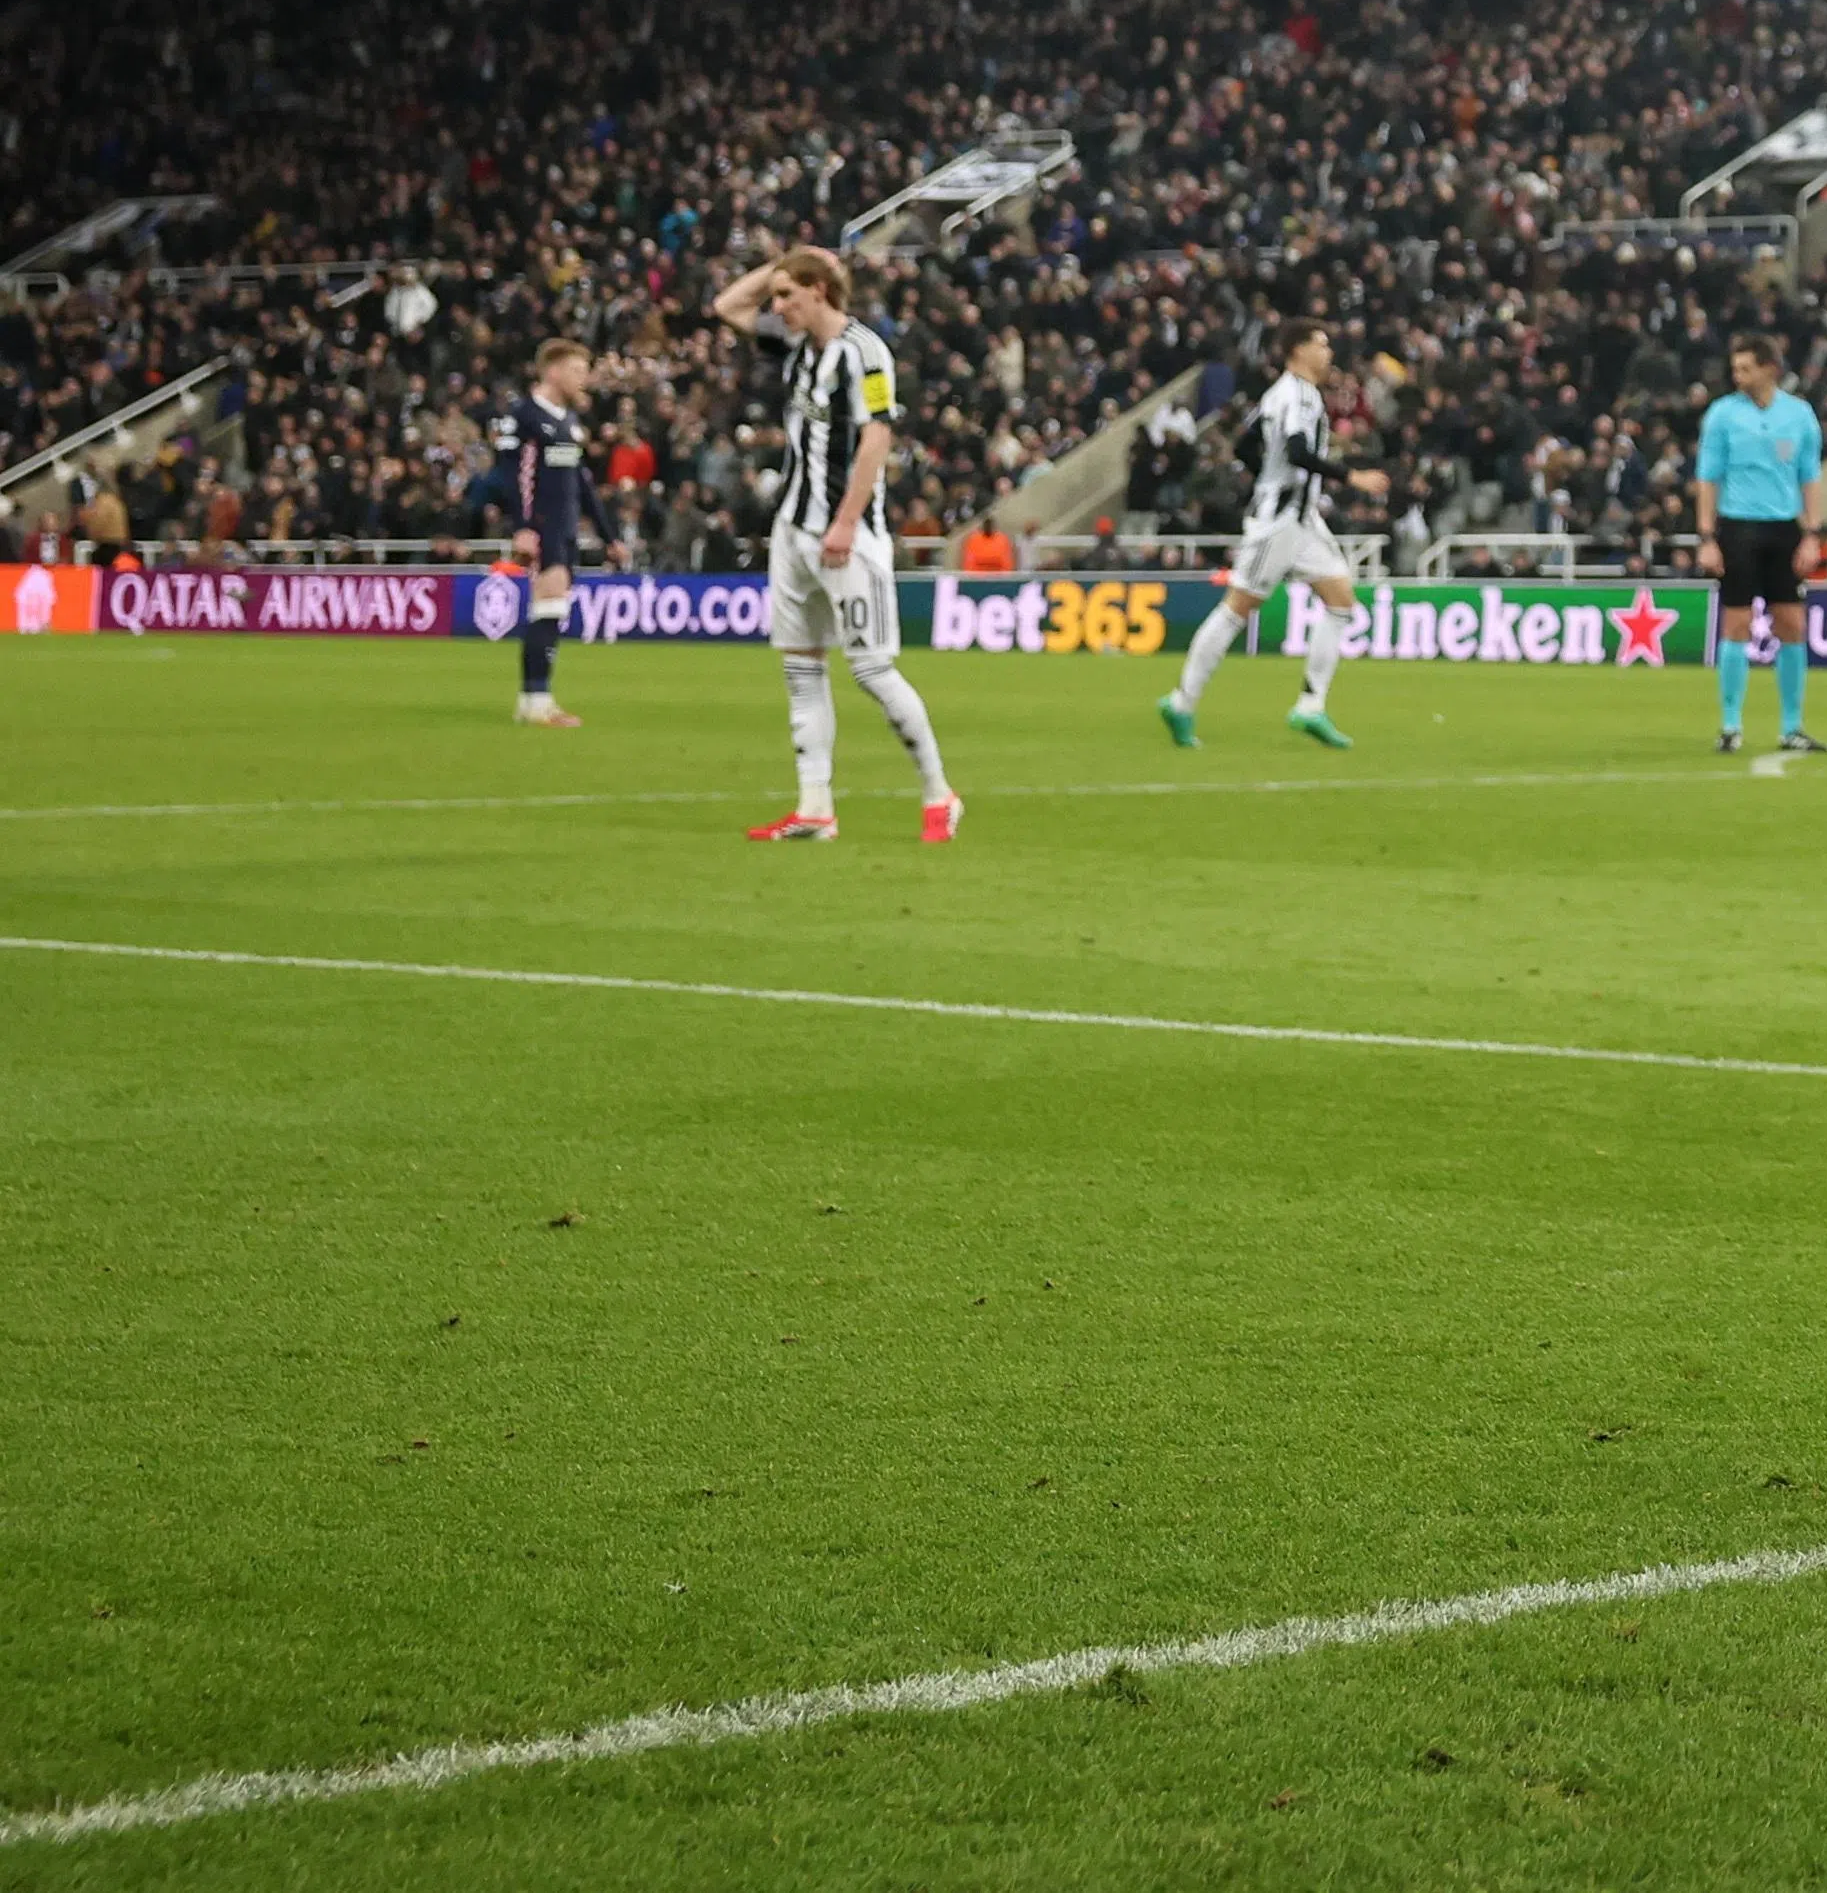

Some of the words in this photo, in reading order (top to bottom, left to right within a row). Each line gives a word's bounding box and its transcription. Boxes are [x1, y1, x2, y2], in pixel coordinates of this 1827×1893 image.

[110, 572, 247, 636] QATAR
[258, 575, 438, 632] AIRWAYS
[558, 577, 772, 644] rypto.co
[838, 597, 868, 629] 10
[930, 575, 1168, 655] bet365
